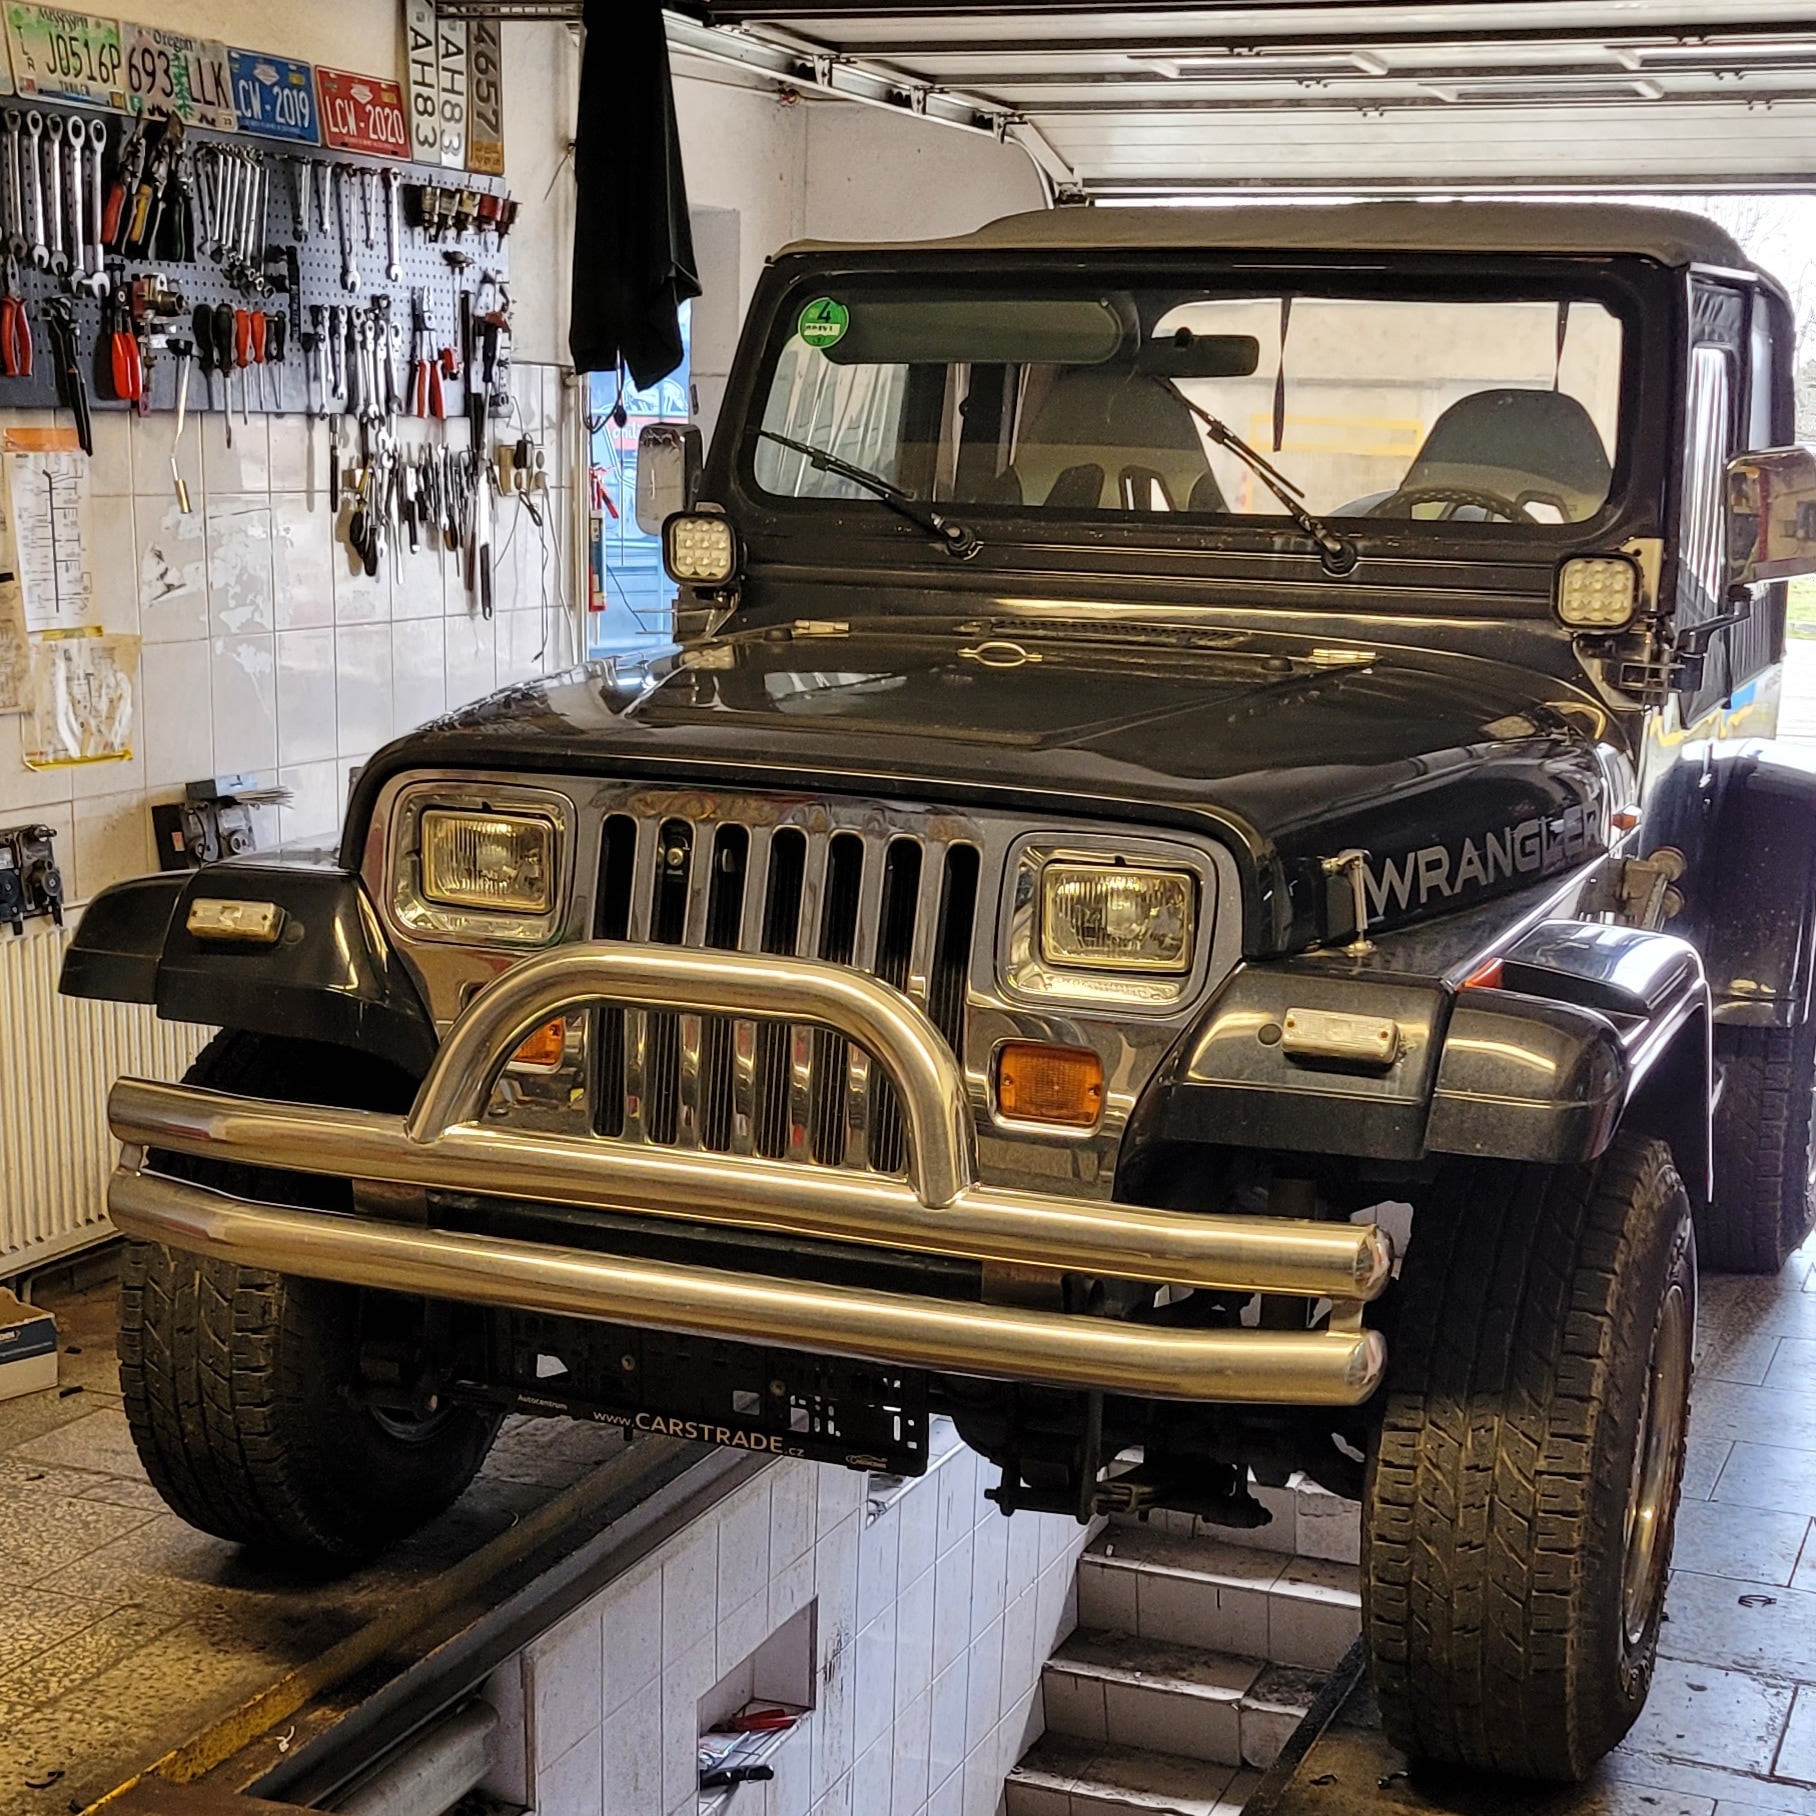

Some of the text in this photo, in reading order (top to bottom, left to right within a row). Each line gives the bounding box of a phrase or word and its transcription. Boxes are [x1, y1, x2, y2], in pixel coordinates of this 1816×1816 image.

[153, 29, 194, 52] Oregon
[128, 47, 174, 98] 693
[184, 55, 229, 109] LLK
[817, 301, 831, 323] 4
[1361, 800, 1601, 916] WRANGLER
